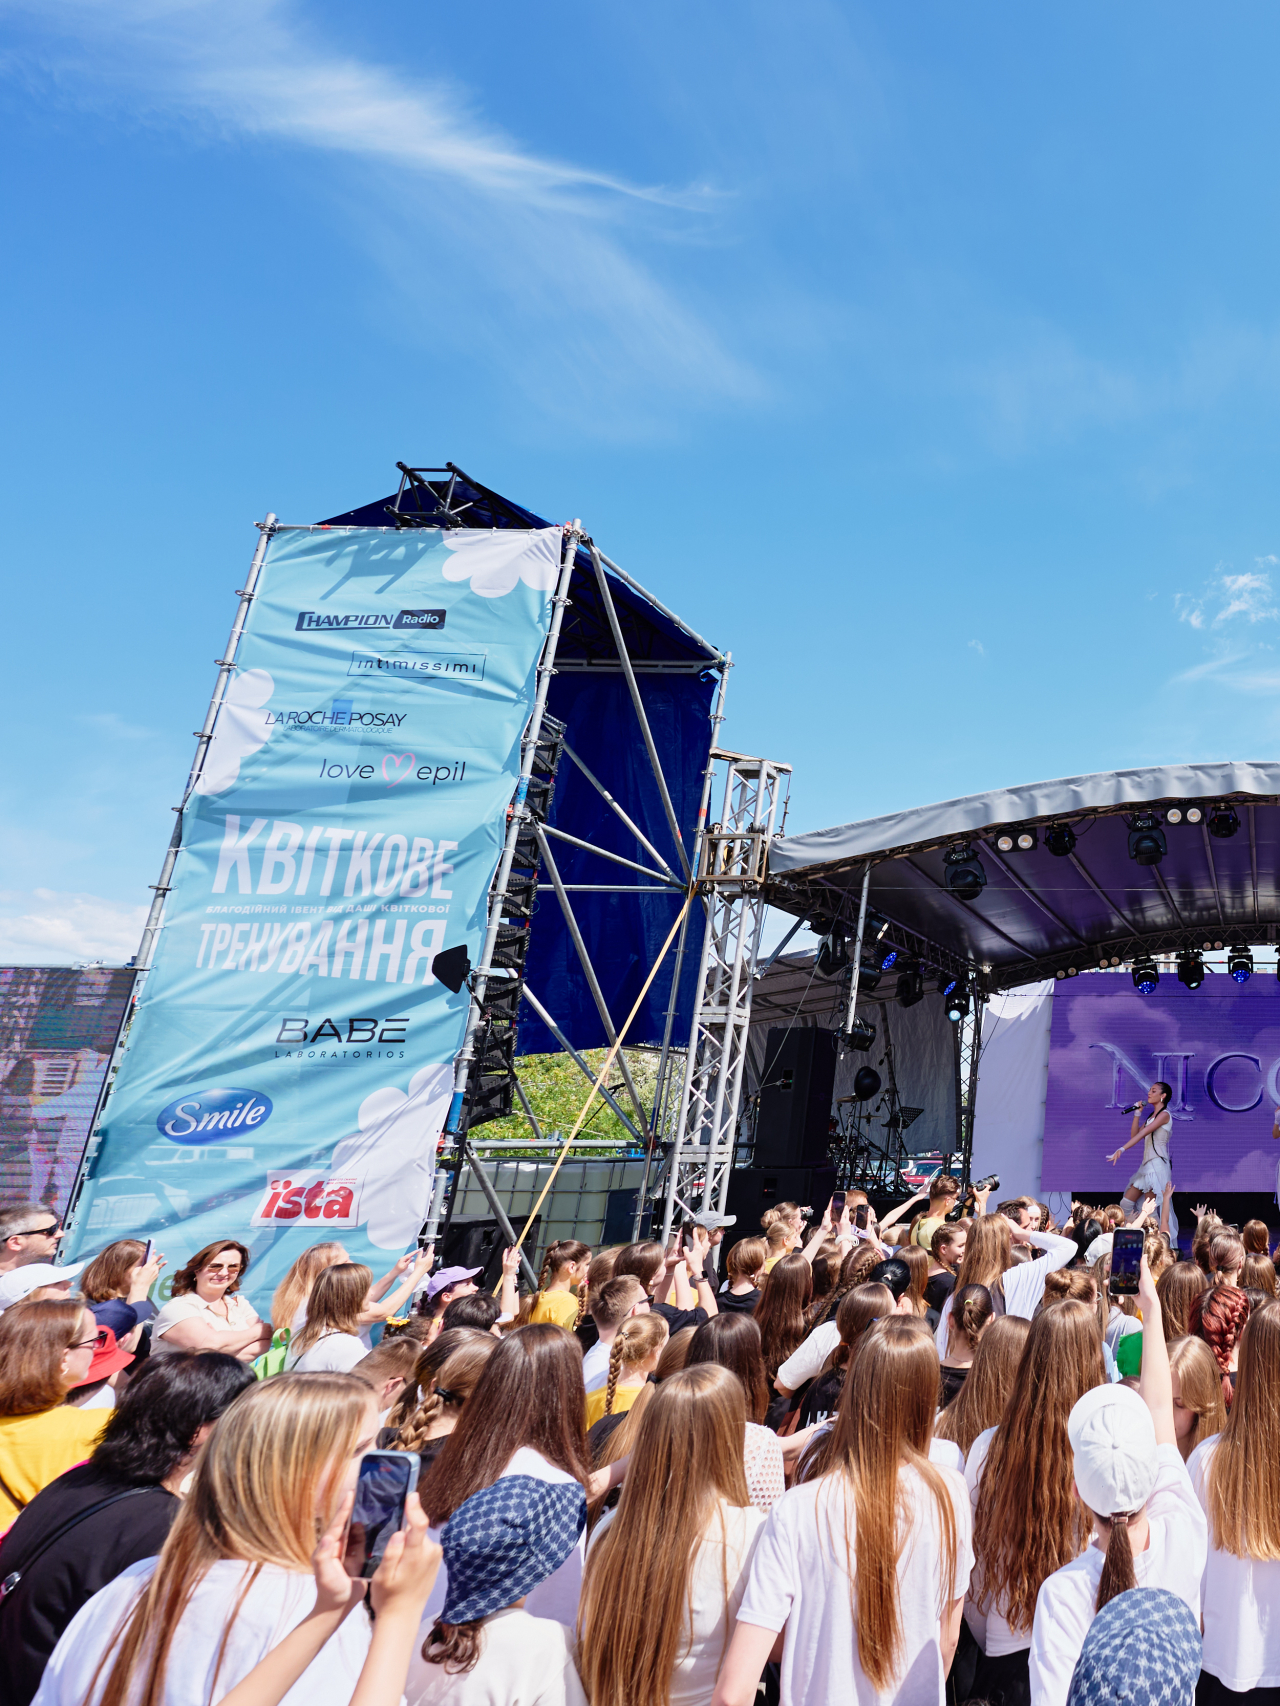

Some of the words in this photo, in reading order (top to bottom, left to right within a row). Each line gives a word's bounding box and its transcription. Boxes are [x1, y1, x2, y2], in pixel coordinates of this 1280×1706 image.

[295, 611, 393, 631] CHAMPION
[402, 613, 439, 624] Radio
[357, 658, 476, 673] intimissimi
[265, 712, 284, 725] LA
[286, 711, 347, 725] ROCHE
[349, 712, 408, 727] POSAY
[320, 759, 375, 780] love
[416, 761, 466, 785] epil
[212, 814, 459, 899] КВІТКОВЕ
[205, 904, 287, 915] БЛАГОДІЙНИЙ
[290, 905, 325, 914] ІВЕНТ
[326, 905, 344, 914] ВІД
[345, 904, 377, 914] ДАШІ
[381, 904, 451, 914] КВІТКОВОЇ
[196, 919, 448, 986] ТРЕНУВАННЯ
[275, 1018, 410, 1043] BABE
[275, 1051, 404, 1059] LABORATORIOS
[165, 1097, 266, 1136] Smile
